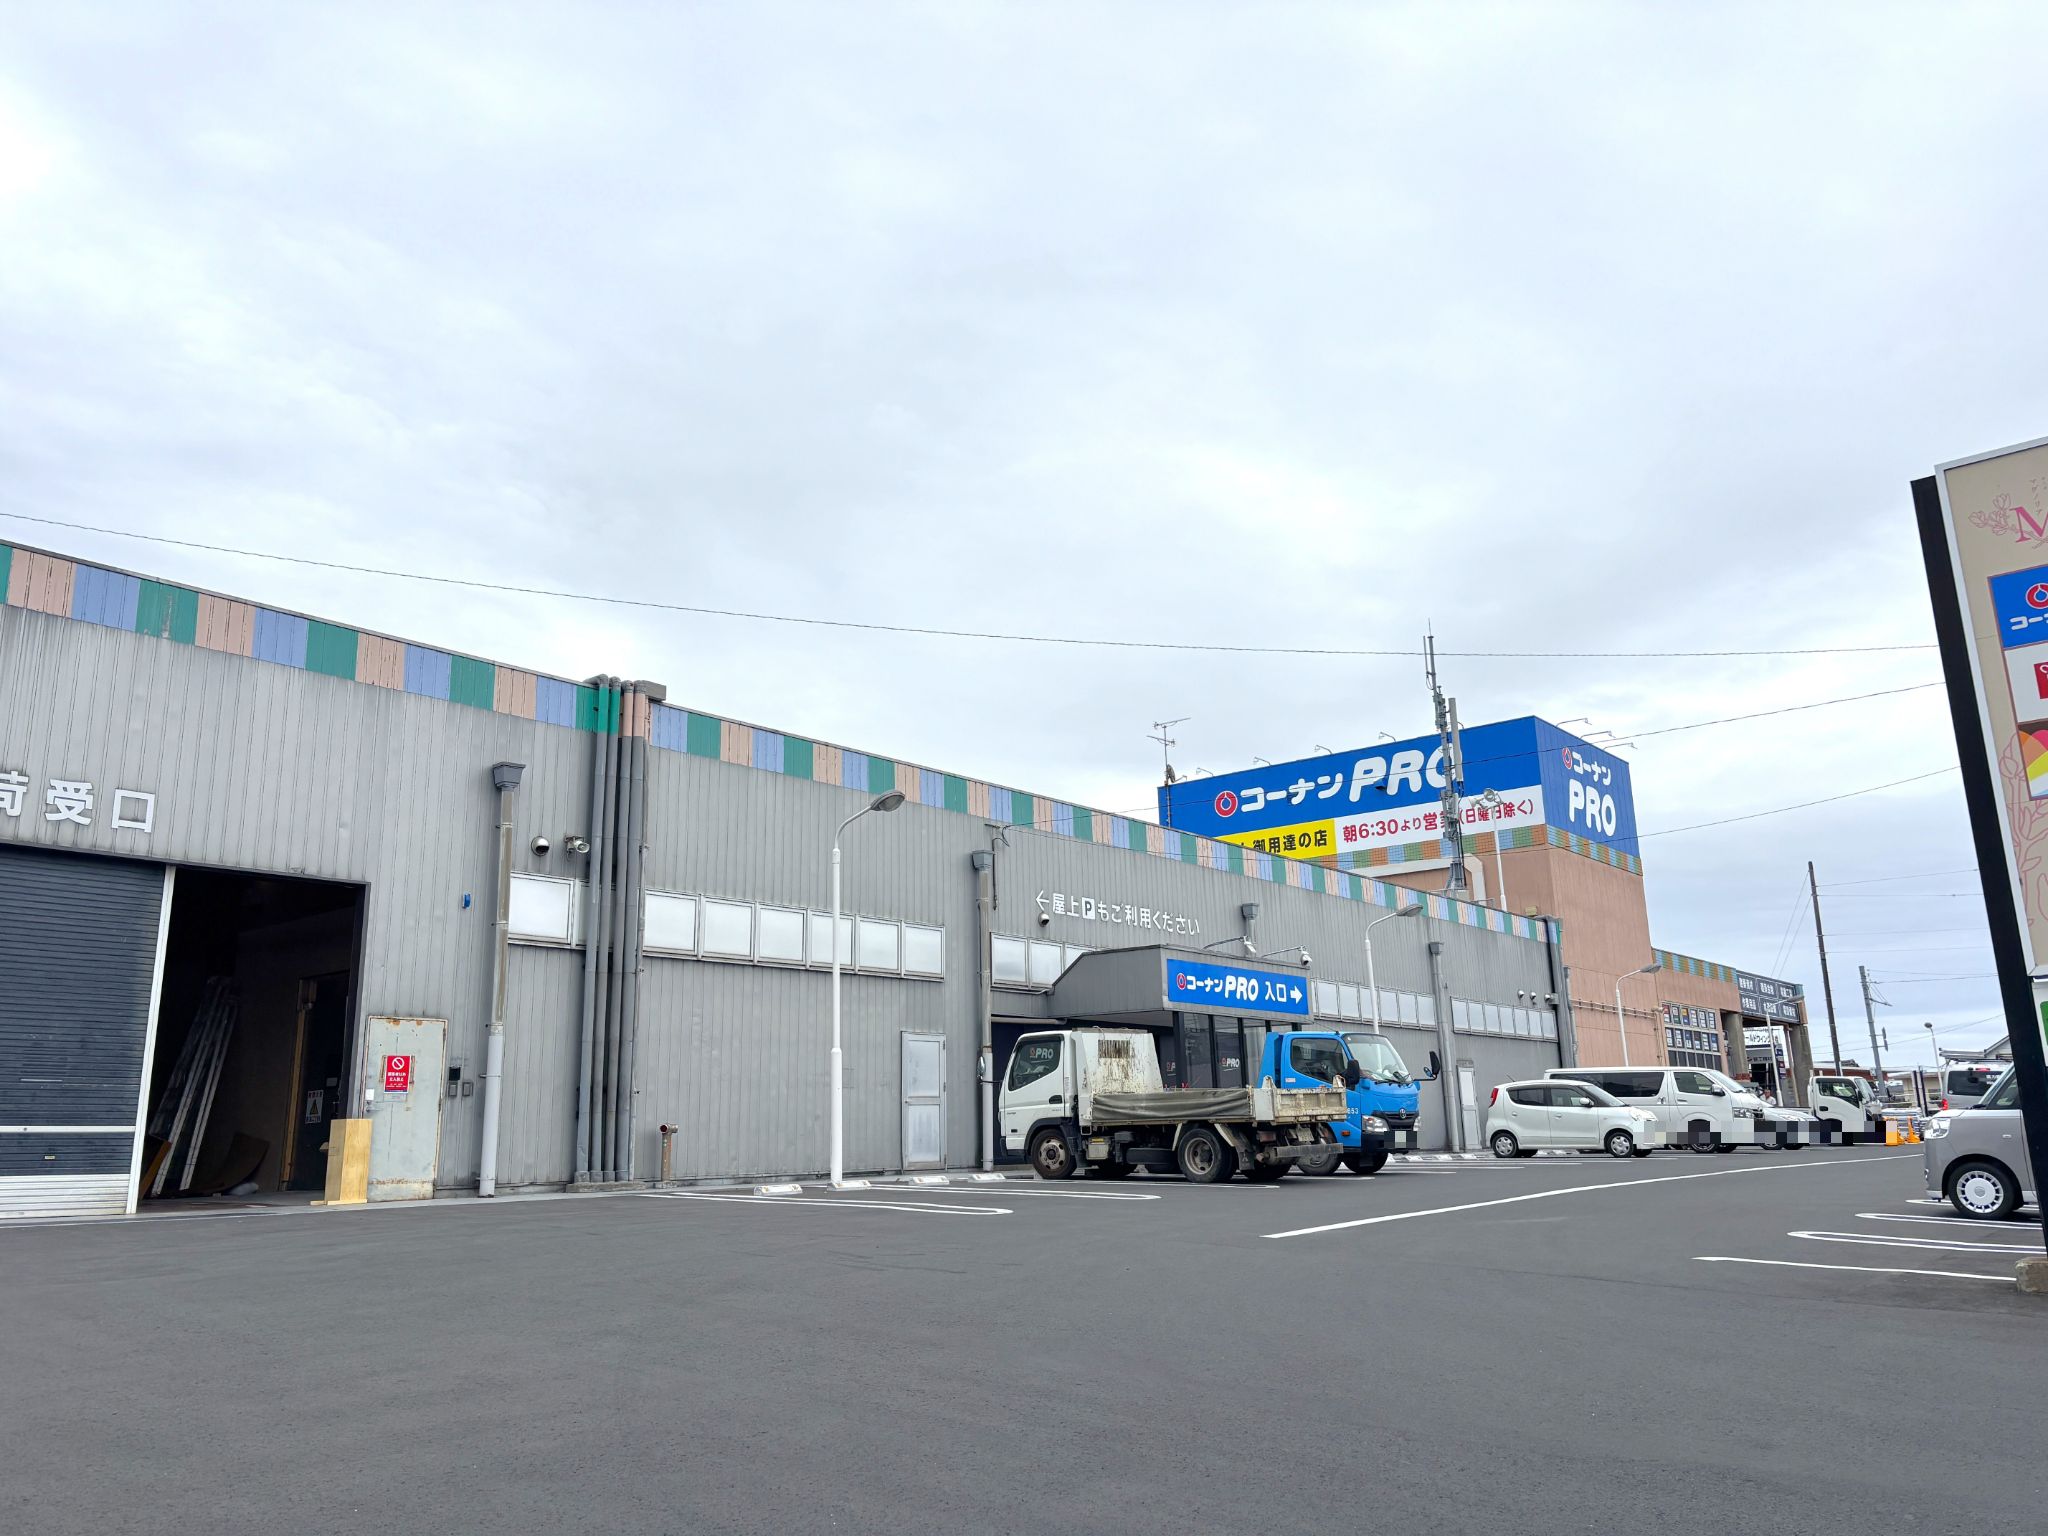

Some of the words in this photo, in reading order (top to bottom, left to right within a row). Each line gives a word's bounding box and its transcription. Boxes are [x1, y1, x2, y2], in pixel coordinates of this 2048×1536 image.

[2010, 613, 2048, 630] コー
[1572, 752, 1612, 786] コーナン
[1569, 778, 1617, 837] PRO
[1265, 981, 1288, 1002] 入口
[1036, 1048, 1054, 1059] PRO
[1226, 1058, 1240, 1068] PRO
